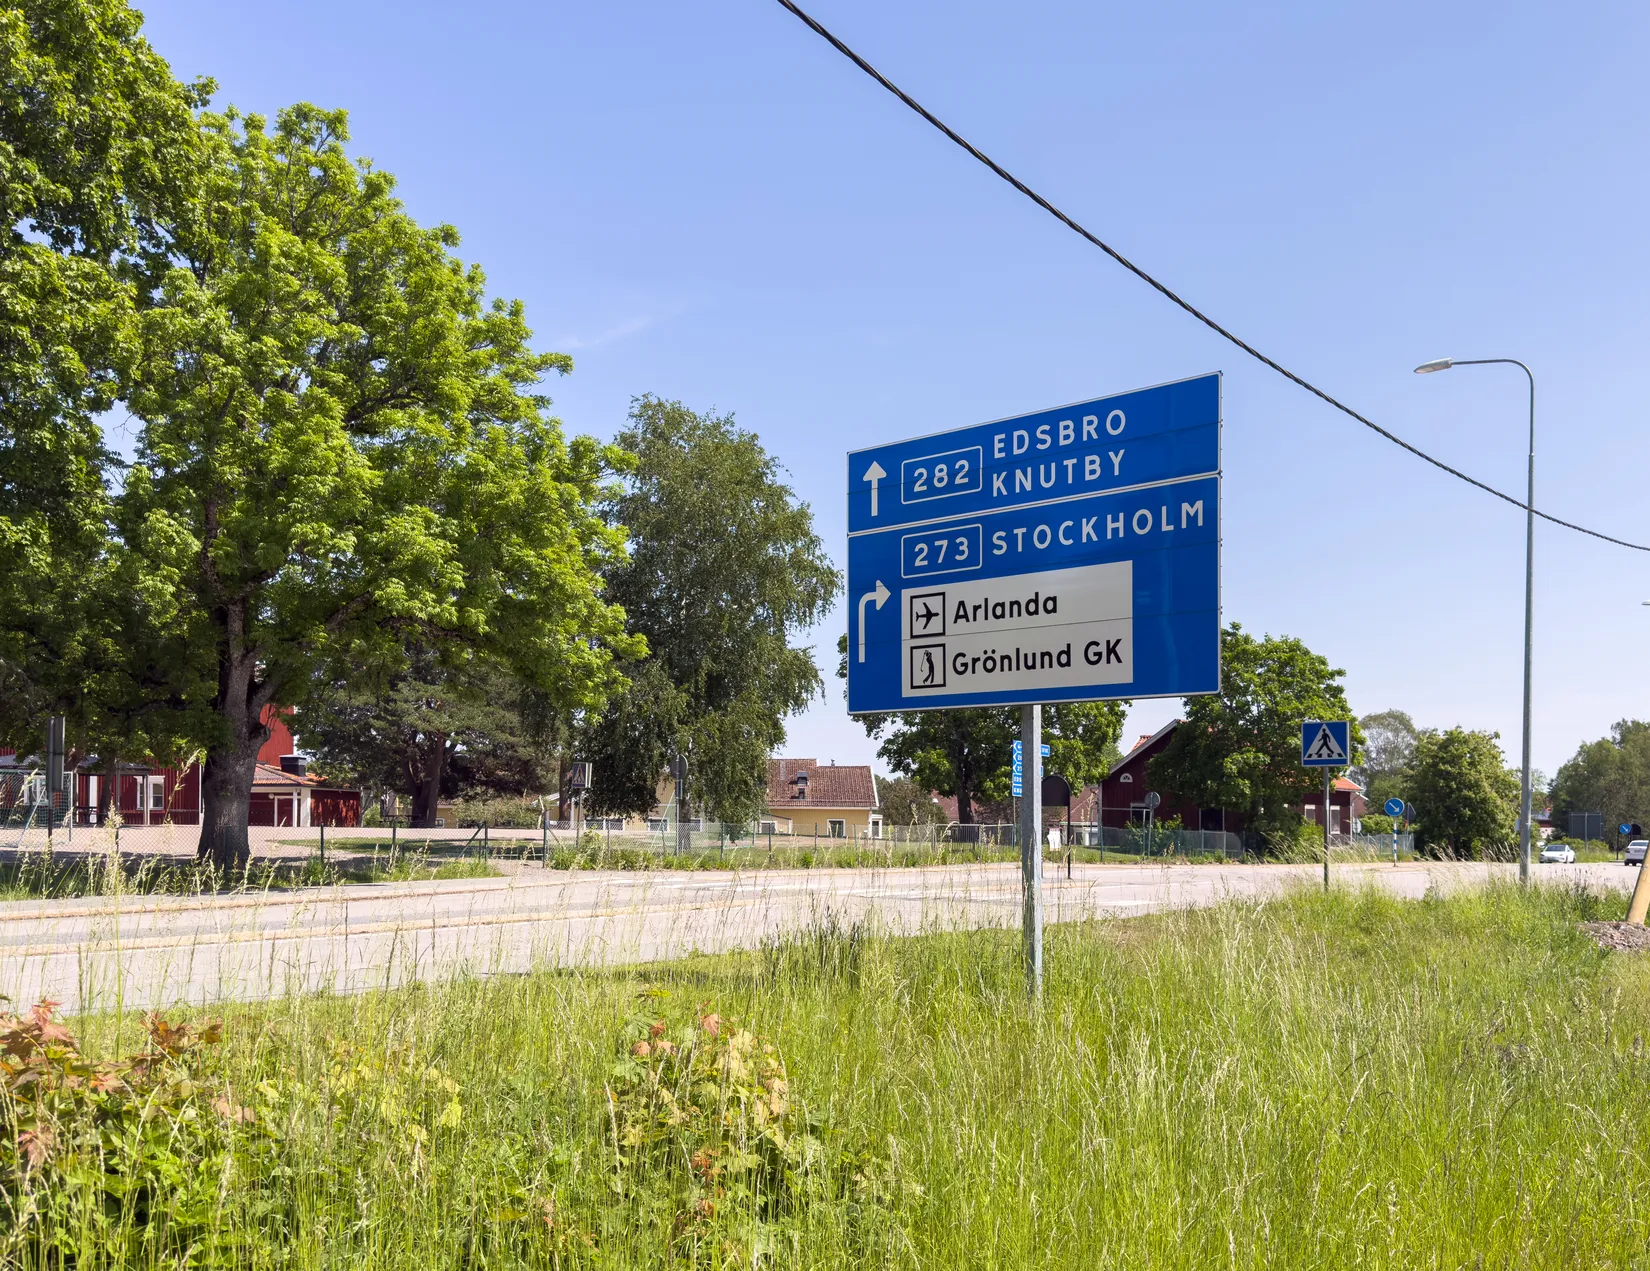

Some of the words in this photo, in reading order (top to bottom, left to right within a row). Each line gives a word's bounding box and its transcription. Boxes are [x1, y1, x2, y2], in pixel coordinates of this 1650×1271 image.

[993, 409, 1126, 459] EDSBRO
[912, 459, 970, 492] 282
[992, 449, 1125, 497] KNUTBY
[913, 536, 969, 566] 273
[992, 500, 1203, 555] STOCKHOLM
[953, 591, 1058, 624] Arlanda
[952, 643, 1071, 675] Grönlund
[1083, 638, 1123, 665] GK
